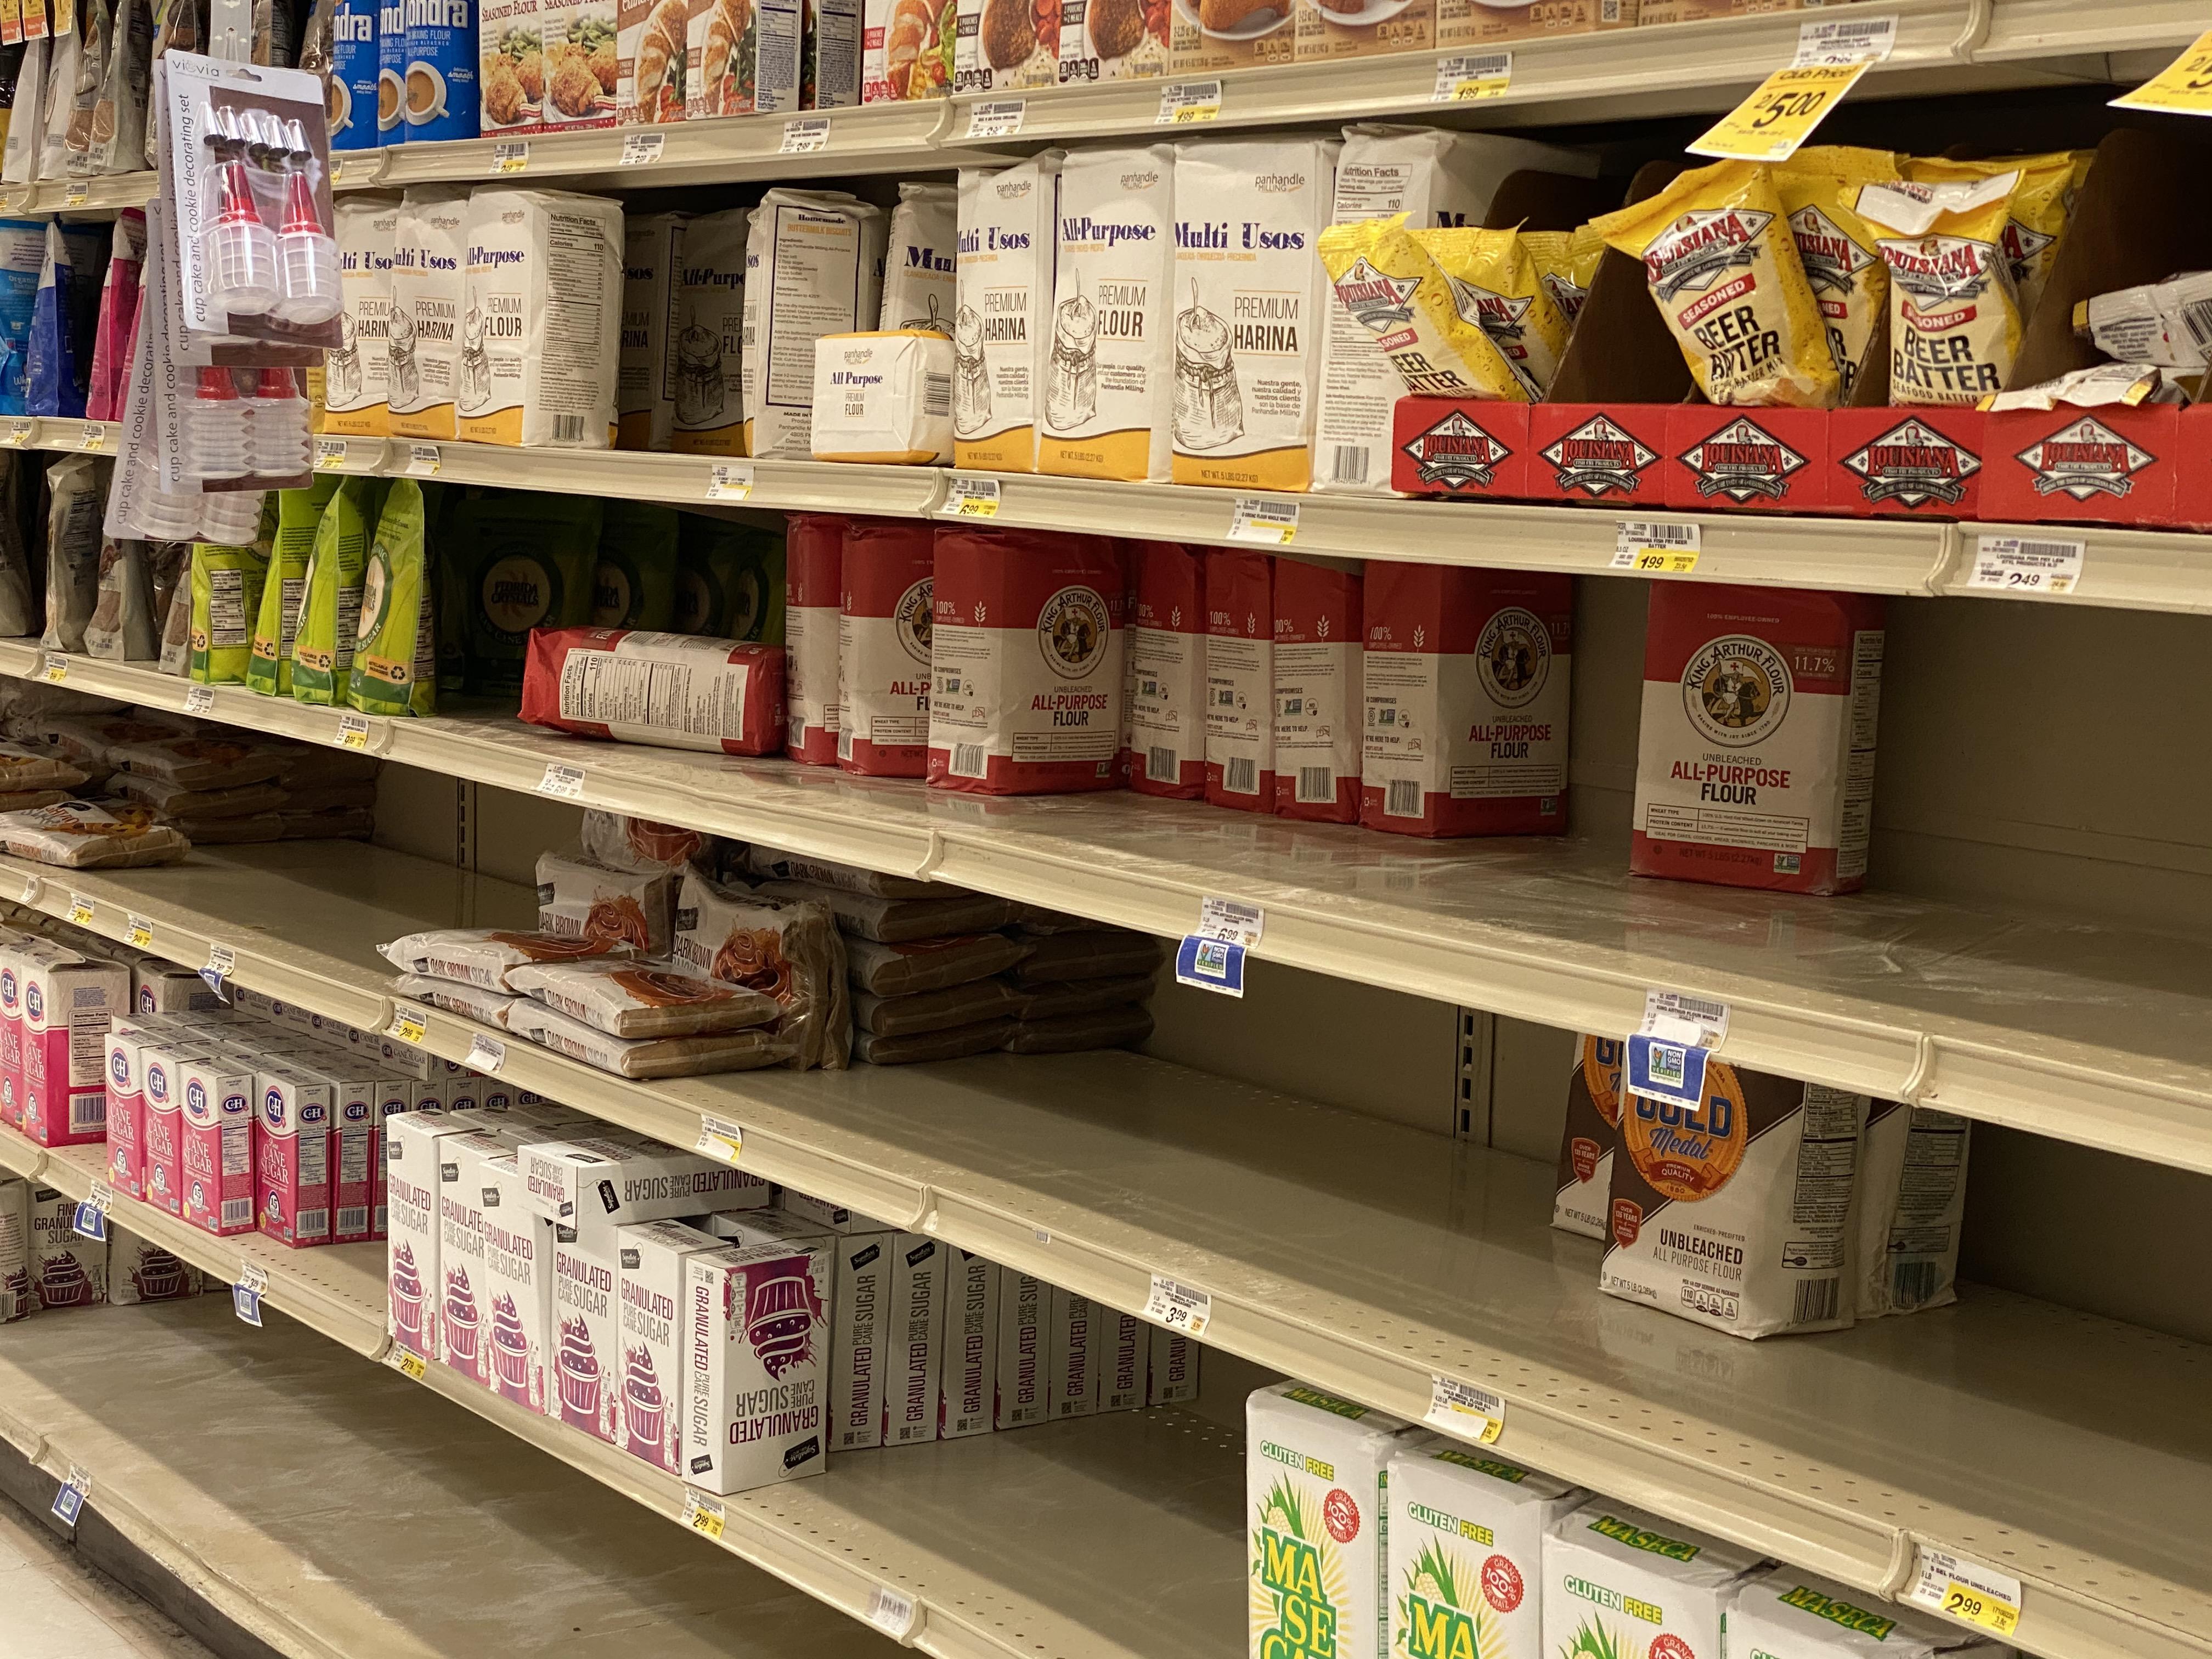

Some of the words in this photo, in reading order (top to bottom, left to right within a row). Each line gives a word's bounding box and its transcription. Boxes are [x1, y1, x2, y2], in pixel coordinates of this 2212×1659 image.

[334, 3, 373, 42] ndra
[482, 5, 512, 22] SEASONED
[514, 1, 537, 16] FLOUR
[431, 31, 451, 40] FLOUR
[178, 94, 190, 114] set
[180, 116, 194, 189] decorating
[1121, 171, 1158, 185] panhandle
[1255, 173, 1305, 188] panhandle
[1374, 167, 1399, 178] Facts
[185, 188, 198, 233] cookie
[1387, 199, 1401, 210] 110
[550, 214, 577, 225] Nutrition
[579, 218, 596, 227] Facts
[788, 224, 826, 235] BUTTERMILK
[826, 227, 851, 236] BISCUITS
[798, 214, 846, 225] Homemade
[550, 240, 573, 248] Calories
[989, 227, 1030, 251] Usos
[1175, 222, 1227, 249] Multi
[1242, 222, 1305, 249] Usos
[188, 236, 202, 262] and
[421, 248, 457, 270] Usos
[193, 264, 203, 294] cake
[196, 296, 205, 321] cup
[416, 302, 455, 319] PREMIUM
[985, 292, 1026, 312] PREMIUM
[1235, 297, 1298, 320] PREMIUM
[1681, 279, 1746, 323] SEASONED
[417, 320, 454, 341] HARINA
[485, 317, 522, 337] FLOUR
[985, 317, 1025, 341] HARINA
[1098, 311, 1142, 337] FLOUR
[1694, 304, 1761, 349] BEER
[1234, 324, 1298, 352] HARINA
[1904, 324, 1973, 363] BEER
[844, 349, 872, 360] panhandle
[1710, 330, 1780, 381] BATTER
[830, 371, 843, 385] All
[845, 373, 883, 388] Purpose
[1893, 348, 2001, 392] BATTER
[845, 393, 865, 402] PREMIUM
[1893, 381, 1934, 400] SEAFOOD
[845, 403, 864, 416] FLOUR
[120, 470, 134, 497] cake
[127, 442, 139, 467] and
[133, 397, 148, 438] cookie
[1423, 434, 1489, 464] LOUISIANA
[1562, 437, 1636, 470] LOUISIANA
[1641, 556, 1664, 569] 199
[2009, 573, 2040, 586] 249
[936, 601, 956, 615] 100%
[1041, 606, 1058, 633] KING
[1057, 592, 1093, 612] ARTHUR
[1091, 601, 1105, 634] FLOUR
[590, 657, 598, 670] 110
[1688, 658, 1711, 691] KING
[1711, 644, 1763, 664] ARTHUR
[1764, 654, 1785, 697] FLOUR
[1795, 656, 1835, 673] 11.7%
[1031, 694, 1108, 710] ALL-PURPOSE
[1053, 711, 1088, 726] FLOUR
[1492, 714, 1532, 723] UNBLEACHED
[1469, 725, 1551, 742] ALL-PURPOSE
[1491, 742, 1528, 759] FLOUR
[1703, 753, 1762, 765] UNBLEACHED
[1671, 760, 1791, 788] ALL-PURPOSE
[1701, 783, 1756, 805] FLOUR
[1650, 807, 1667, 815] WHEAT
[430, 958, 447, 975] DARK
[447, 961, 471, 981] BROWN
[548, 1030, 564, 1048] DARK
[564, 1037, 587, 1061] BROWN
[587, 1047, 608, 1070] SUGAR
[1667, 1057, 1681, 1065] GMO
[1652, 1067, 1680, 1078] VERIFIED
[111, 1103, 131, 1126] CANE
[109, 1117, 134, 1141] SUGAR
[149, 1119, 170, 1142] CANE
[146, 1133, 174, 1158] SUGAR
[1649, 1127, 1714, 1161] Medal
[118, 1153, 125, 1165] 15
[1661, 1167, 1695, 1183] QUALITY
[388, 1173, 431, 1212] GRANULATED
[401, 1205, 428, 1237] SUGAR
[484, 1221, 533, 1261] GRANULATED
[1660, 1228, 1743, 1265] UNBLEACHED
[500, 1255, 531, 1286] SUGAR
[556, 1250, 612, 1293] GRANULATED
[1653, 1246, 1667, 1262] ALL
[1671, 1250, 1709, 1274] PURPOSE
[1713, 1259, 1741, 1282] FLOUR
[558, 1276, 573, 1293] PURE
[1683, 1288, 1693, 1300] 110
[557, 1288, 572, 1305] CANE
[573, 1288, 607, 1318] SUGAR
[620, 1277, 673, 1322] GRANULATED
[855, 1274, 876, 1323] SUGAR
[637, 1316, 670, 1348] SUGAR
[695, 1285, 709, 1371] GRANULATED
[791, 1379, 815, 1394] CANE
[850, 1346, 872, 1427] GRANULATED
[906, 1342, 928, 1422] GRANULATED
[736, 1385, 789, 1418] SUGAR
[791, 1391, 814, 1409] PURE
[1448, 1395, 1466, 1405] PURPOSE
[693, 1396, 708, 1447] SUGAR
[729, 1405, 819, 1444] GRANULATED
[1260, 1440, 1304, 1469] GLUTEN
[1305, 1457, 1335, 1481] FREE
[1334, 1492, 1356, 1516] GRANO
[1327, 1502, 1353, 1532] 100%
[1327, 1516, 1335, 1532] DE
[1332, 1527, 1347, 1542] MAIZ
[1408, 1502, 1458, 1534] GLUTEN
[1460, 1520, 1494, 1547] FREE
[1590, 1515, 1698, 1562] MASECA
[1266, 1535, 1322, 1604] MA
[1486, 1568, 1517, 1603] 100%
[1949, 1572, 1970, 1585] FLOUR
[1971, 1580, 2012, 1602] UNBLEACHED
[1563, 1575, 1621, 1611] GLUTEN
[1623, 1594, 1663, 1626] FREE
[1782, 1587, 1896, 1638] MASECA
[1944, 1593, 1982, 1615] 299
[1285, 1596, 1332, 1657] SE
